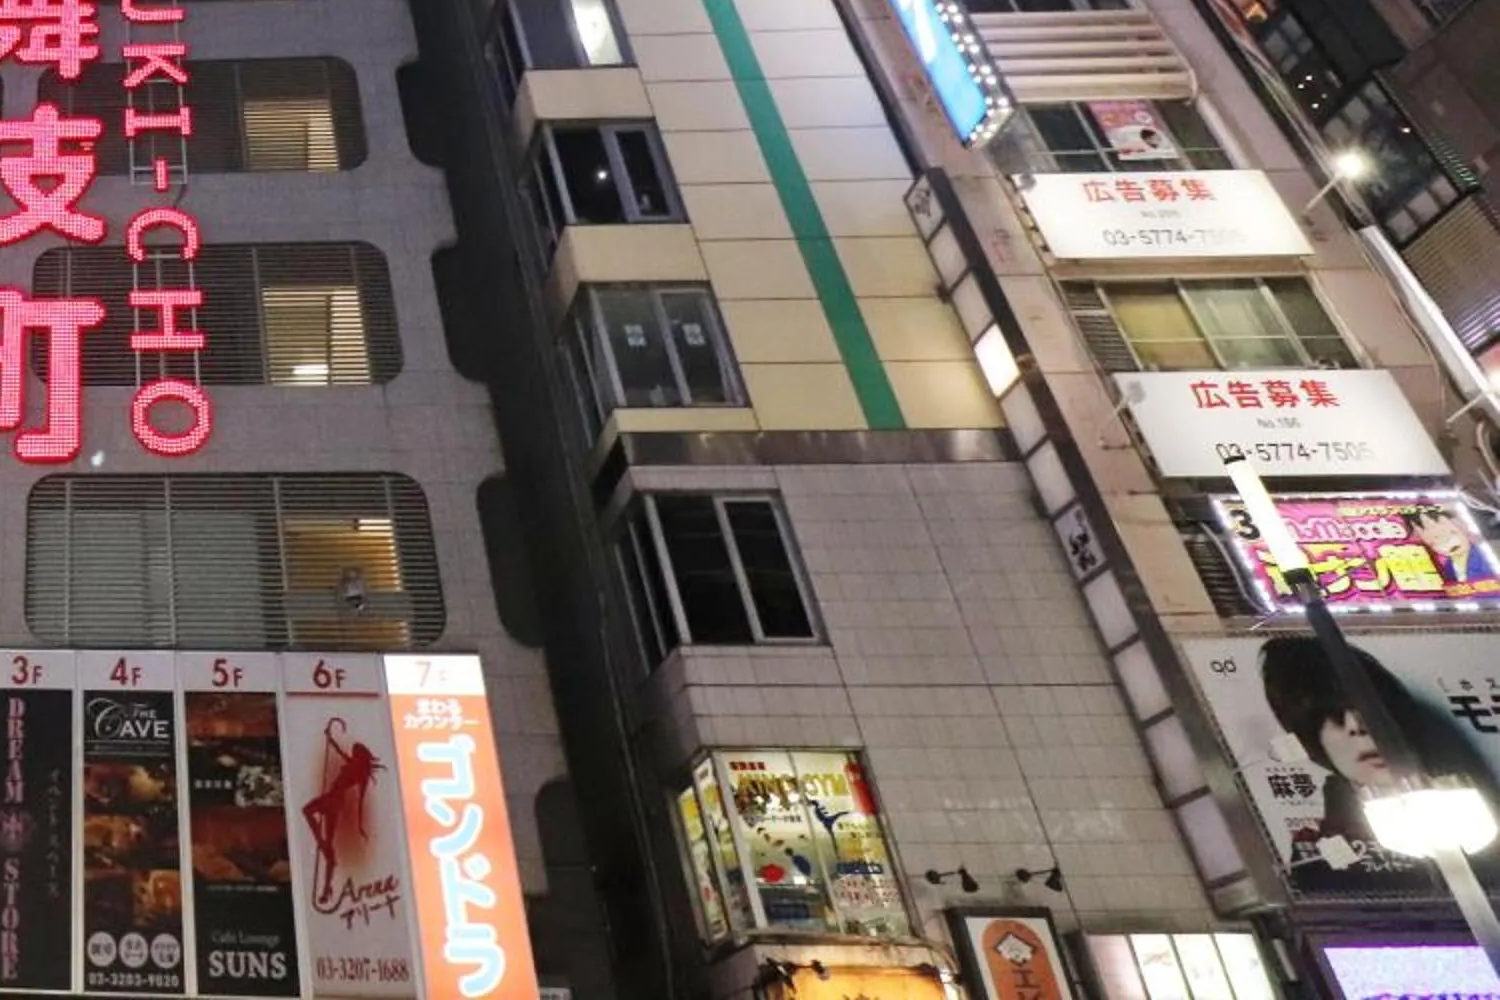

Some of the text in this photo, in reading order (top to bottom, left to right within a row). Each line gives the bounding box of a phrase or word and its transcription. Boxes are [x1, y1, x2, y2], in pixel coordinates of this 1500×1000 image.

[1082, 178, 1218, 203] 広告募集
[1189, 379, 1341, 410] 広告募集
[11, 655, 43, 685] 3F
[110, 656, 142, 688] 4F
[211, 657, 243, 688] 5F
[312, 660, 347, 690] 6F
[0, 697, 26, 981] DREAM STORE
[415, 732, 507, 998] ゴンドラ
[340, 894, 401, 930] アリーナ
[208, 951, 288, 980] SUNS
